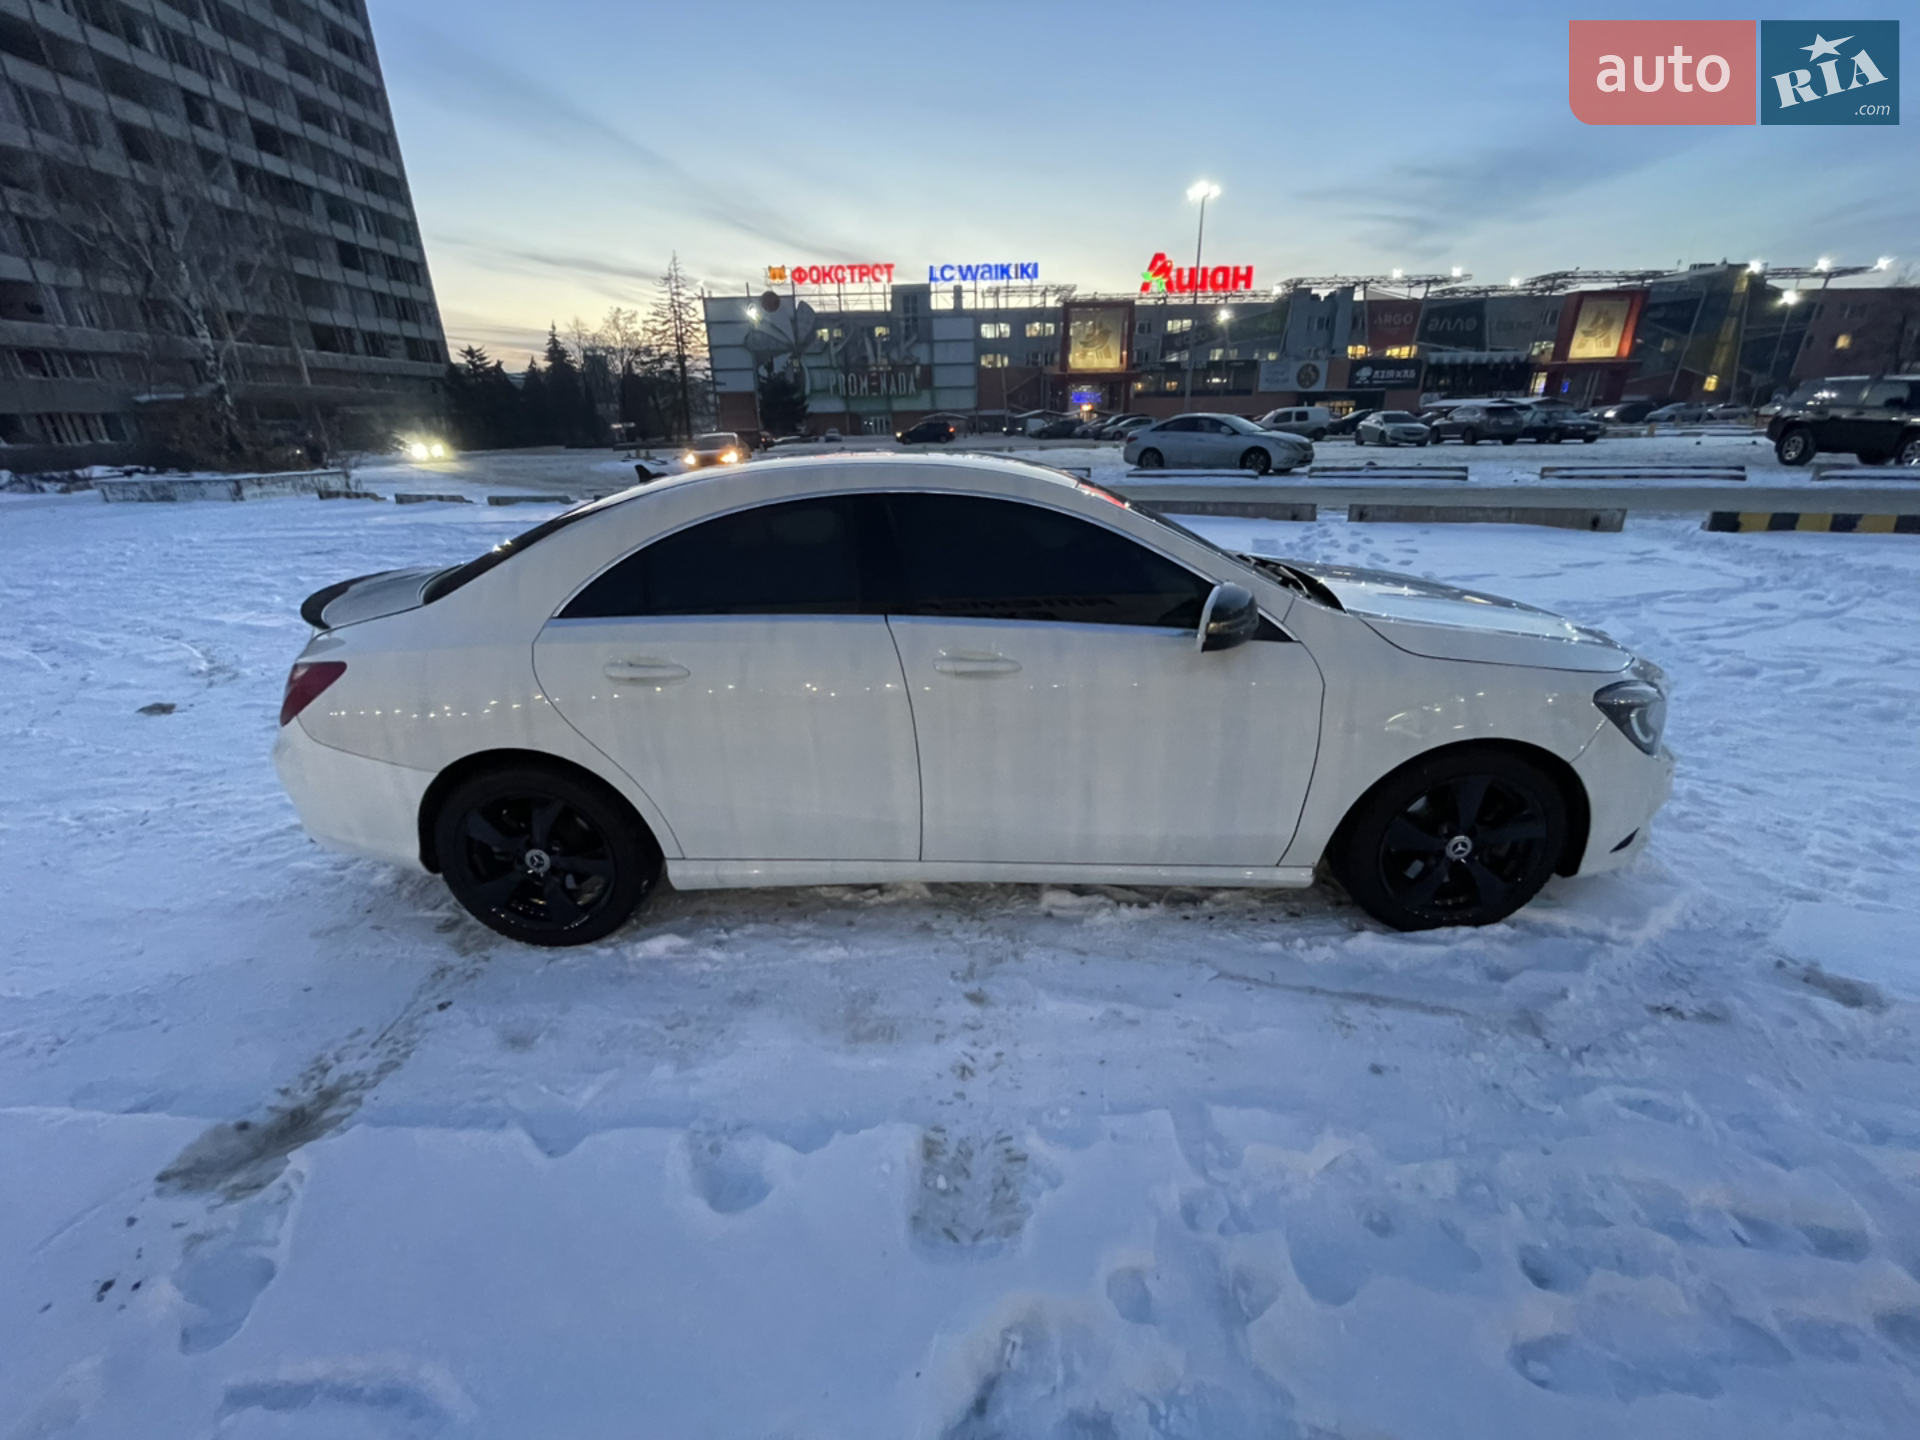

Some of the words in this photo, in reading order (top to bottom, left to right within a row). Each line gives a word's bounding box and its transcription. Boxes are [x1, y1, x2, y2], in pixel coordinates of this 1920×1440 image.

[791, 263, 895, 285] ФОКСТРОТ
[1140, 252, 1253, 293] Ашан
[829, 372, 917, 396] PROMENADA
